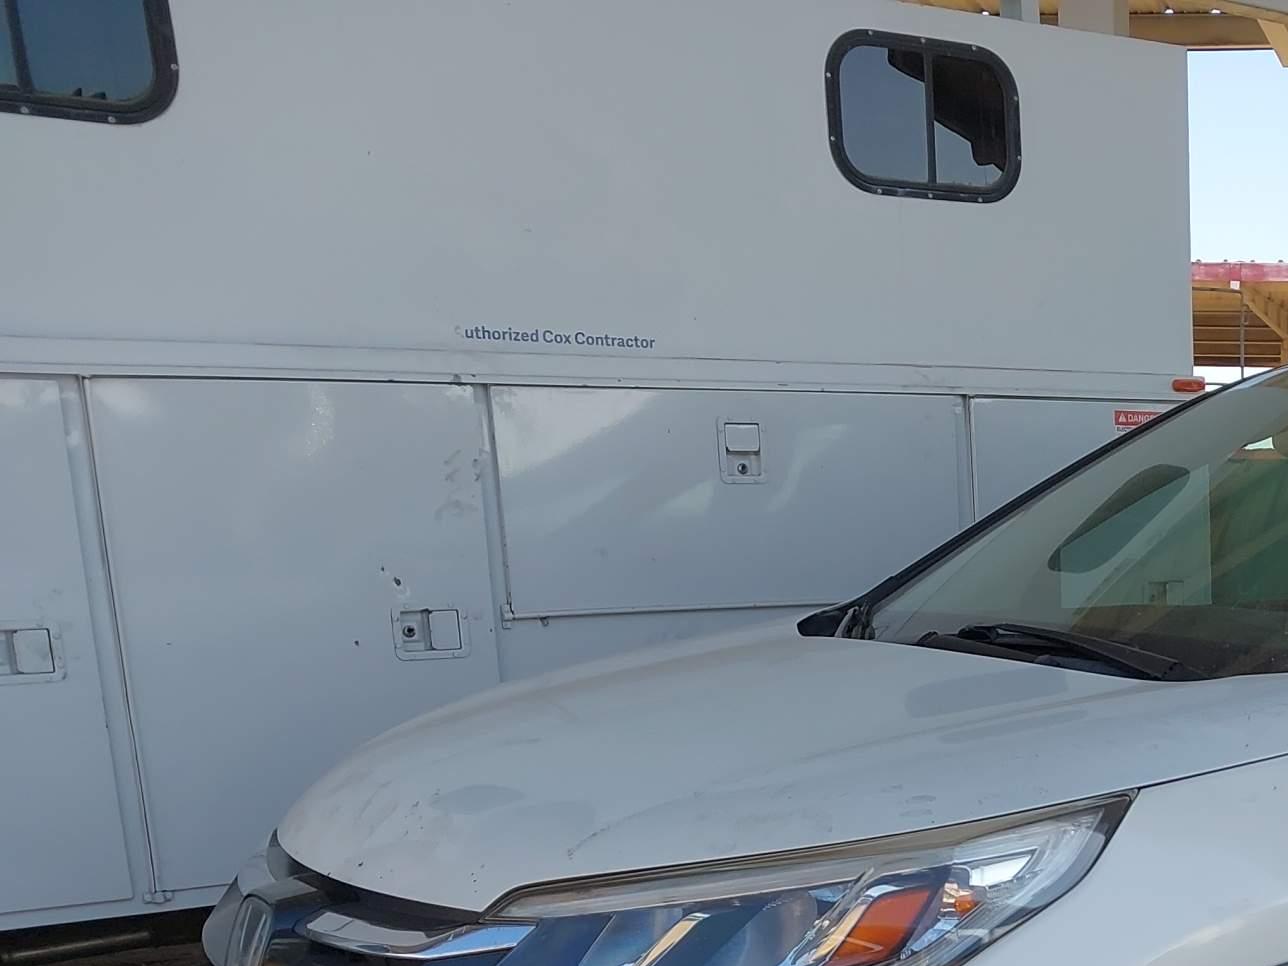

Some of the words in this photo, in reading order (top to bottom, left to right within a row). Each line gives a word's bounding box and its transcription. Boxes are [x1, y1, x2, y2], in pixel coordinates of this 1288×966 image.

[458, 325, 539, 342] uthorized
[542, 330, 572, 344] Cox
[574, 332, 656, 348] Contractor
